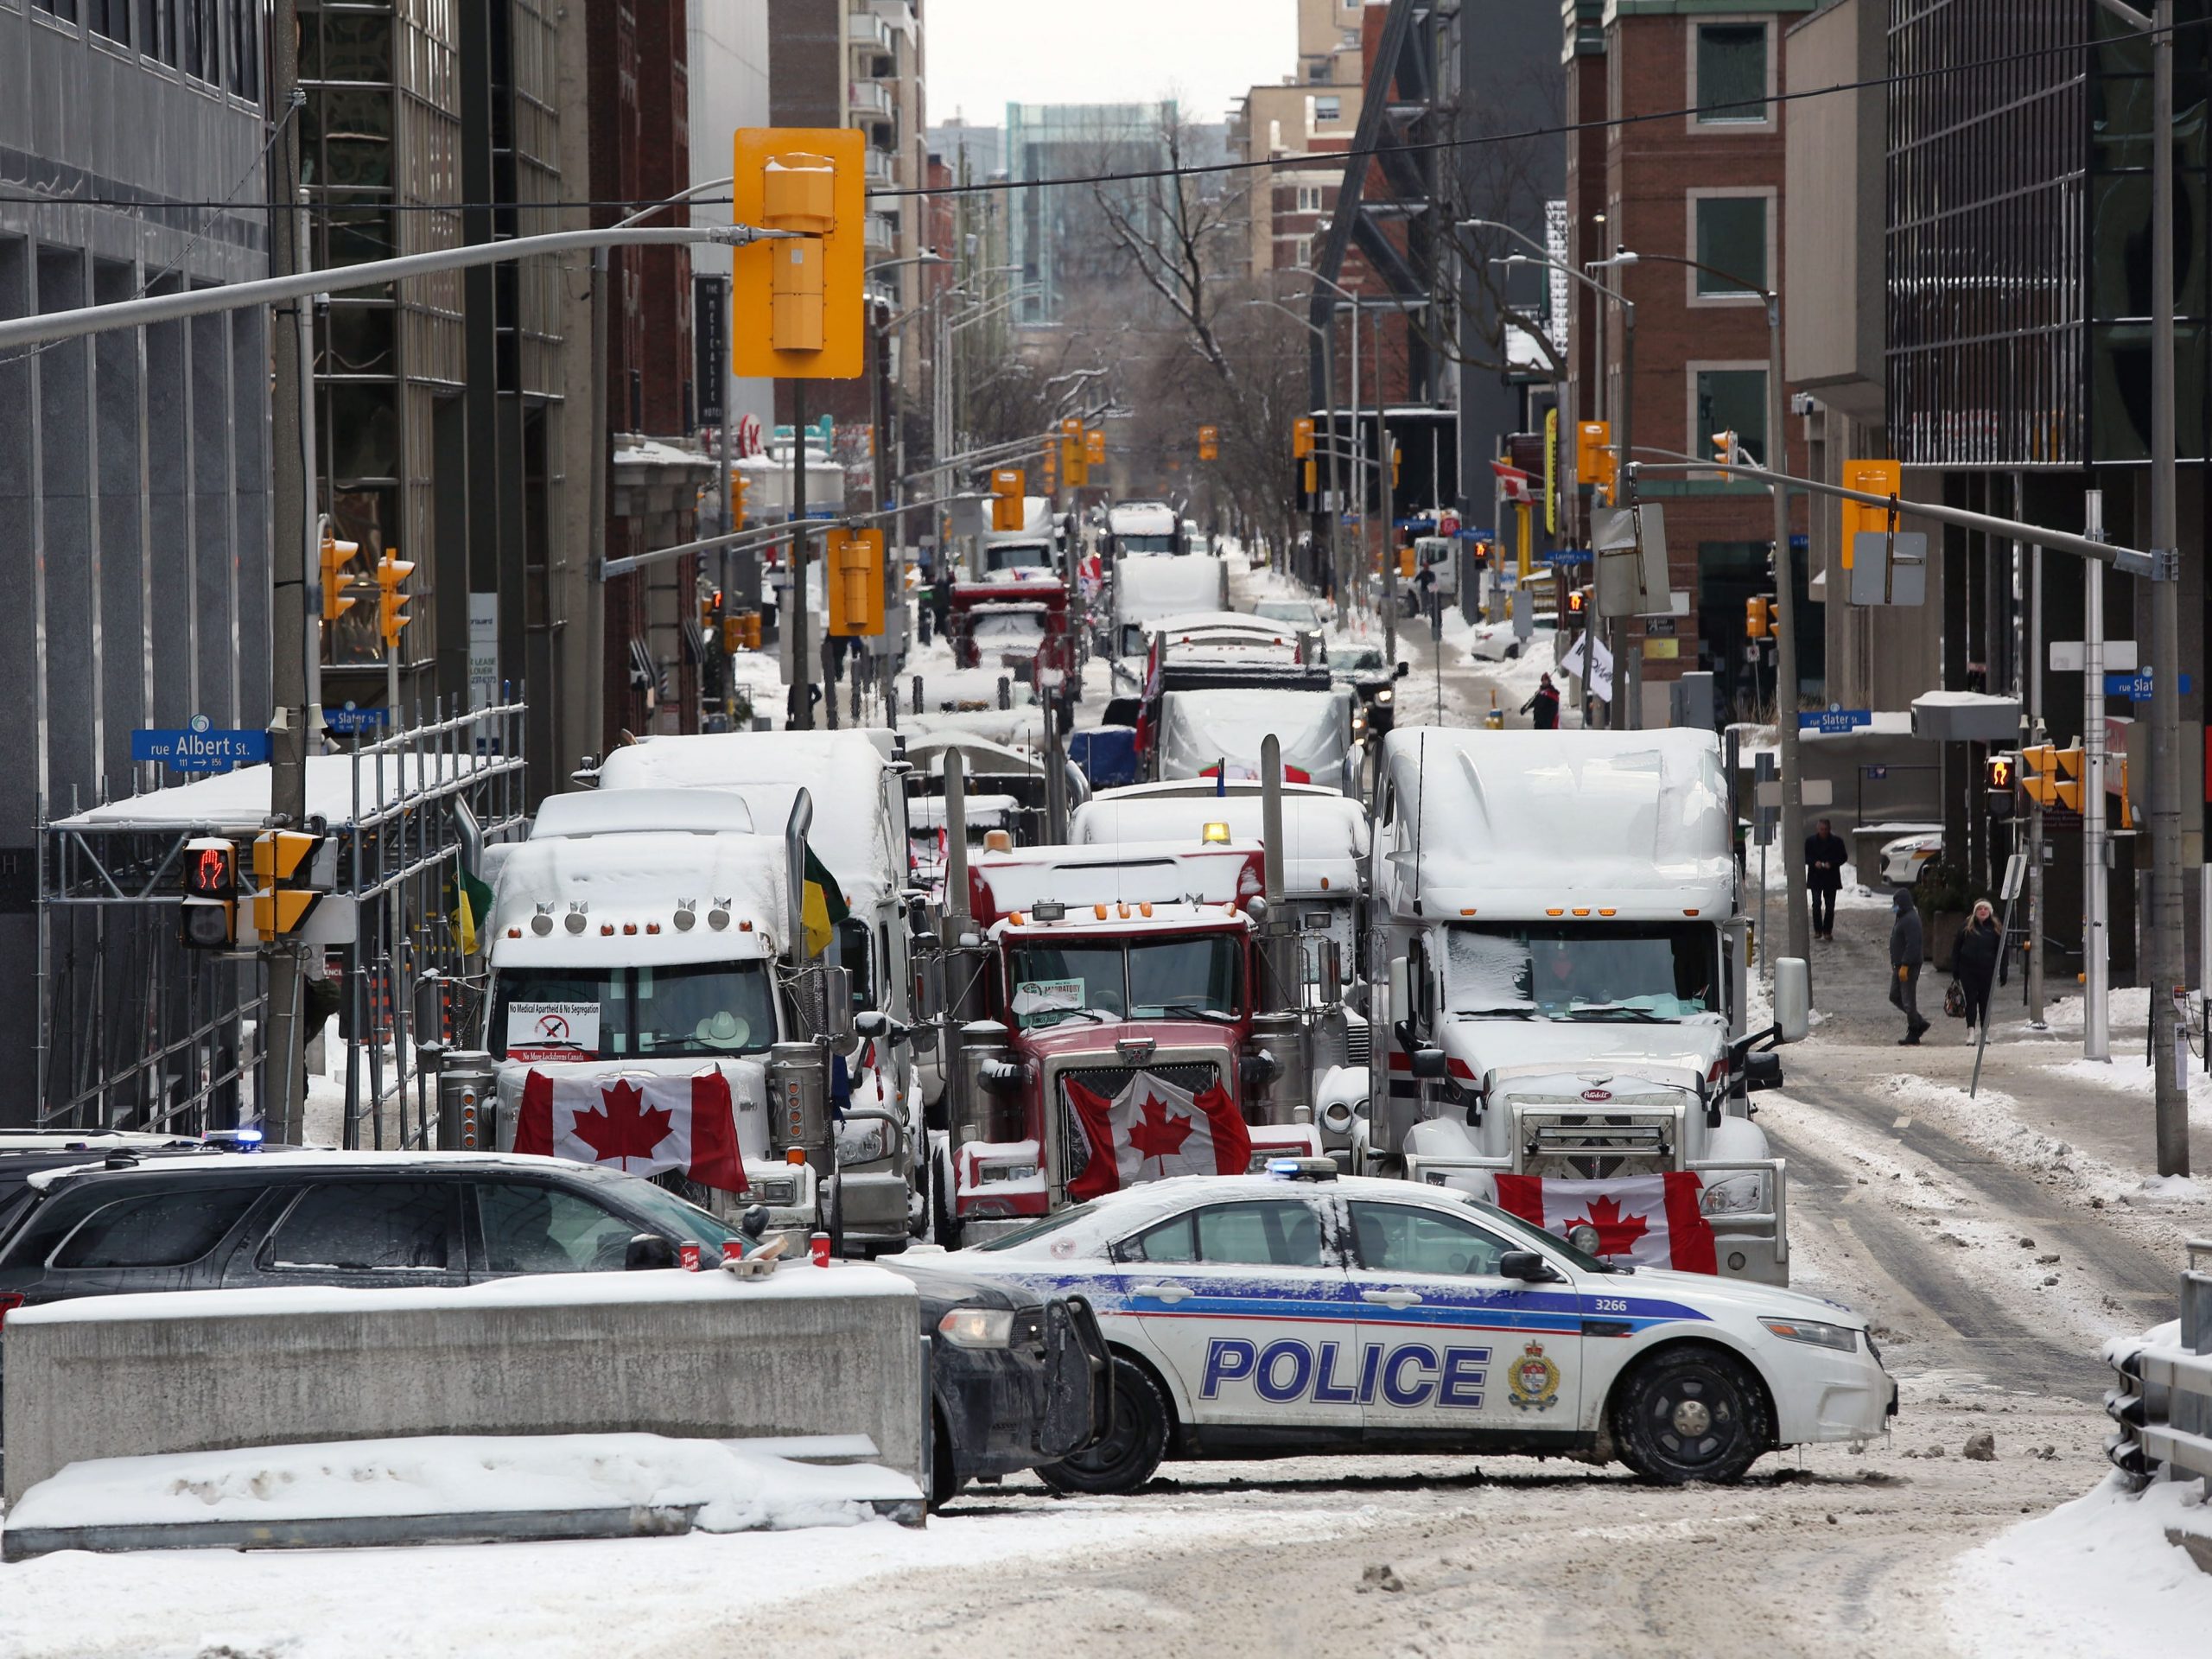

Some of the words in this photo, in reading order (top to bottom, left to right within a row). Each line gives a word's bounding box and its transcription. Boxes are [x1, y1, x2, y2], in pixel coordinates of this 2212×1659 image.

[1822, 714, 1849, 726] Slater
[150, 745, 170, 756] rue
[175, 734, 230, 756] Albert
[235, 742, 251, 756] St.
[179, 758, 188, 767] 111
[211, 758, 222, 767] 856
[510, 1004, 516, 1014] No
[518, 1004, 535, 1014] Medical
[536, 1004, 559, 1015] Apartheid
[559, 1004, 563, 1014] &
[564, 1004, 571, 1014] No
[571, 1004, 599, 1015] Segregation
[523, 1052, 529, 1060] No
[530, 1052, 542, 1061] More
[543, 1052, 567, 1061] Lockdowns
[567, 1052, 584, 1061] Canada
[683, 1251, 697, 1263] Tim
[1595, 1299, 1627, 1312] 3266
[1199, 1337, 1492, 1409] POLICE
